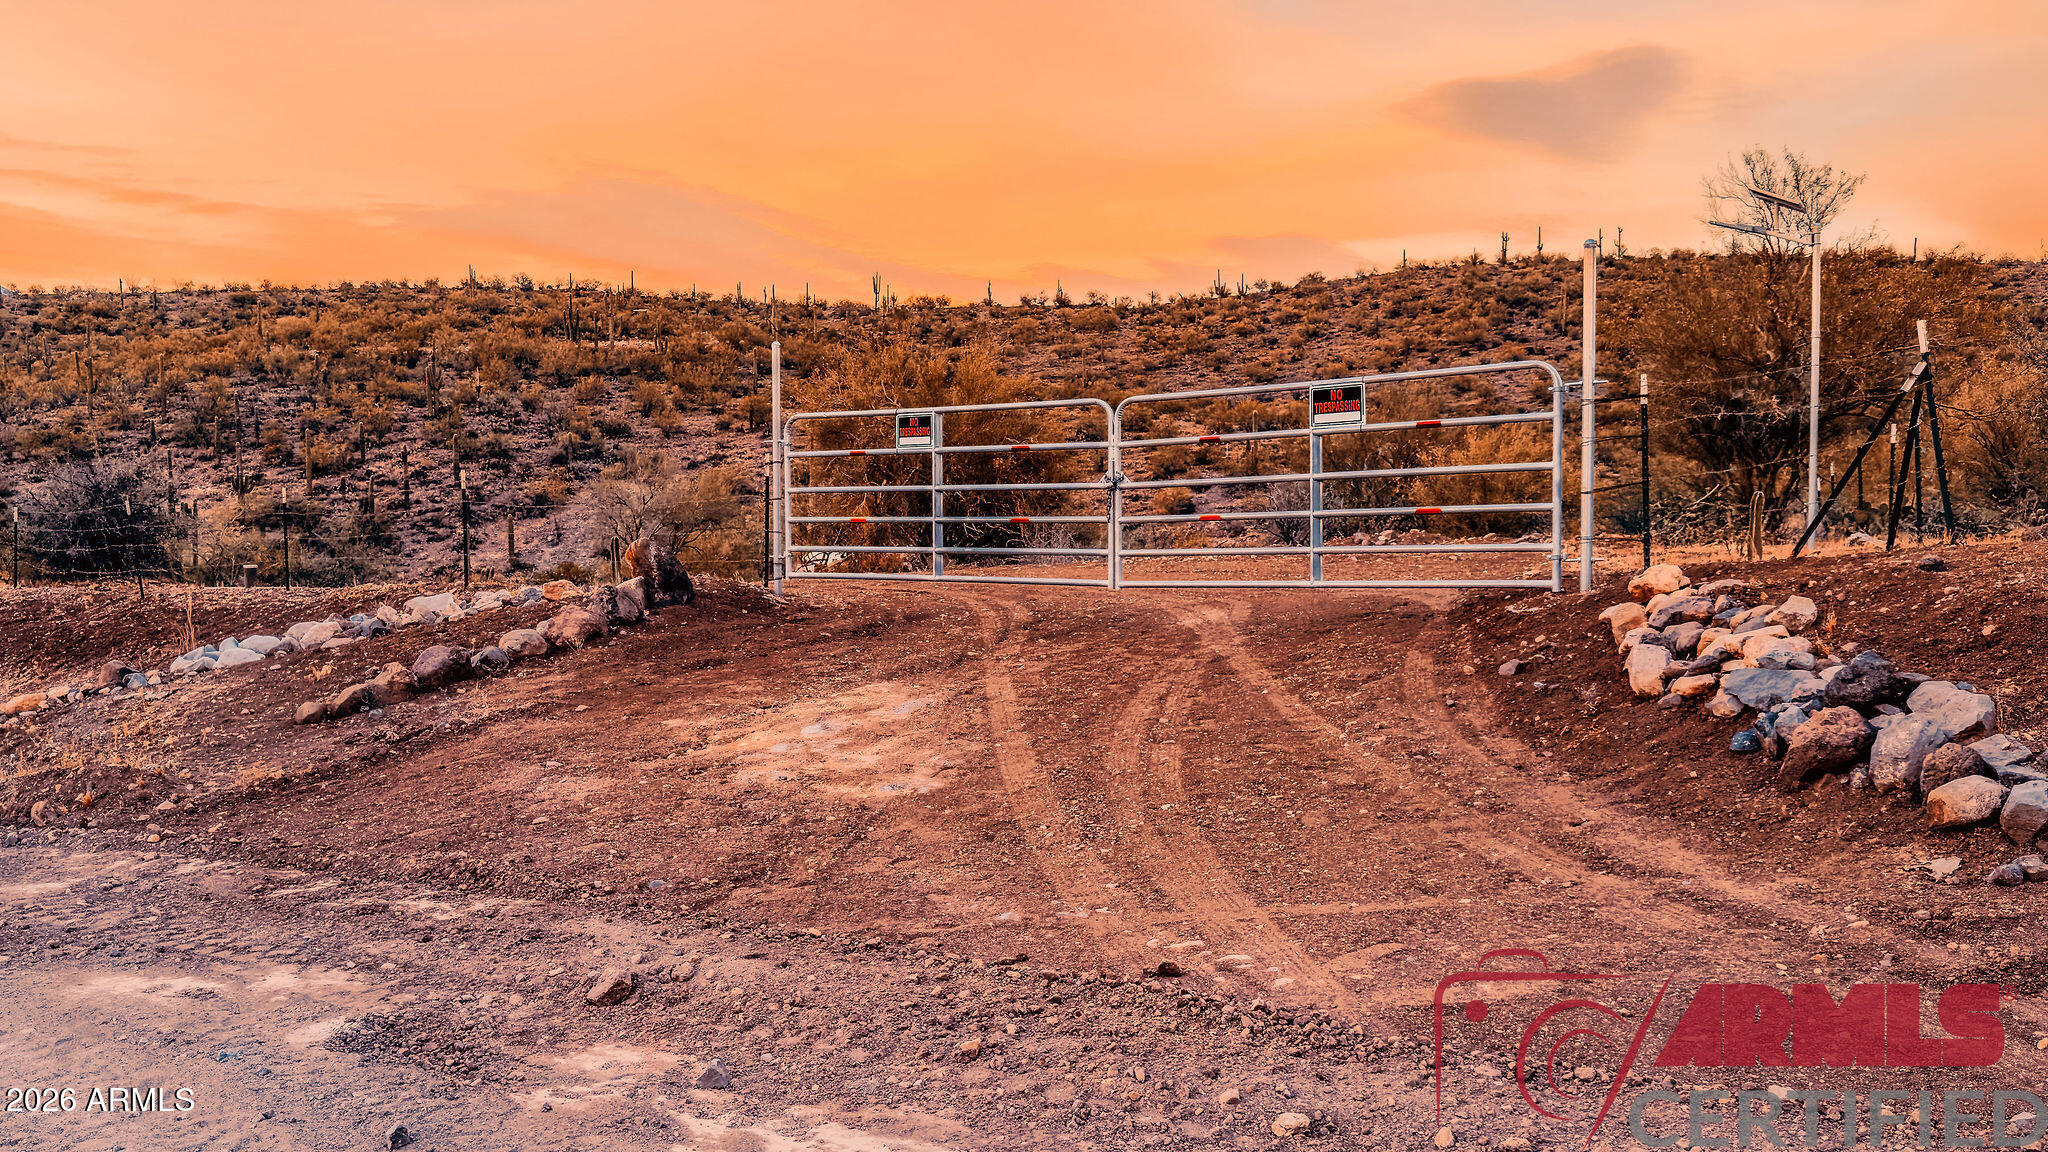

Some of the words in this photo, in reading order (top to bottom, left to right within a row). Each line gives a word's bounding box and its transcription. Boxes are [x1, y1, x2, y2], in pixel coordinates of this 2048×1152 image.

[1330, 389, 1343, 401] NO
[1314, 399, 1361, 414] TRESPASSING
[909, 417, 919, 427] NO
[899, 426, 931, 437] TRESPASSING
